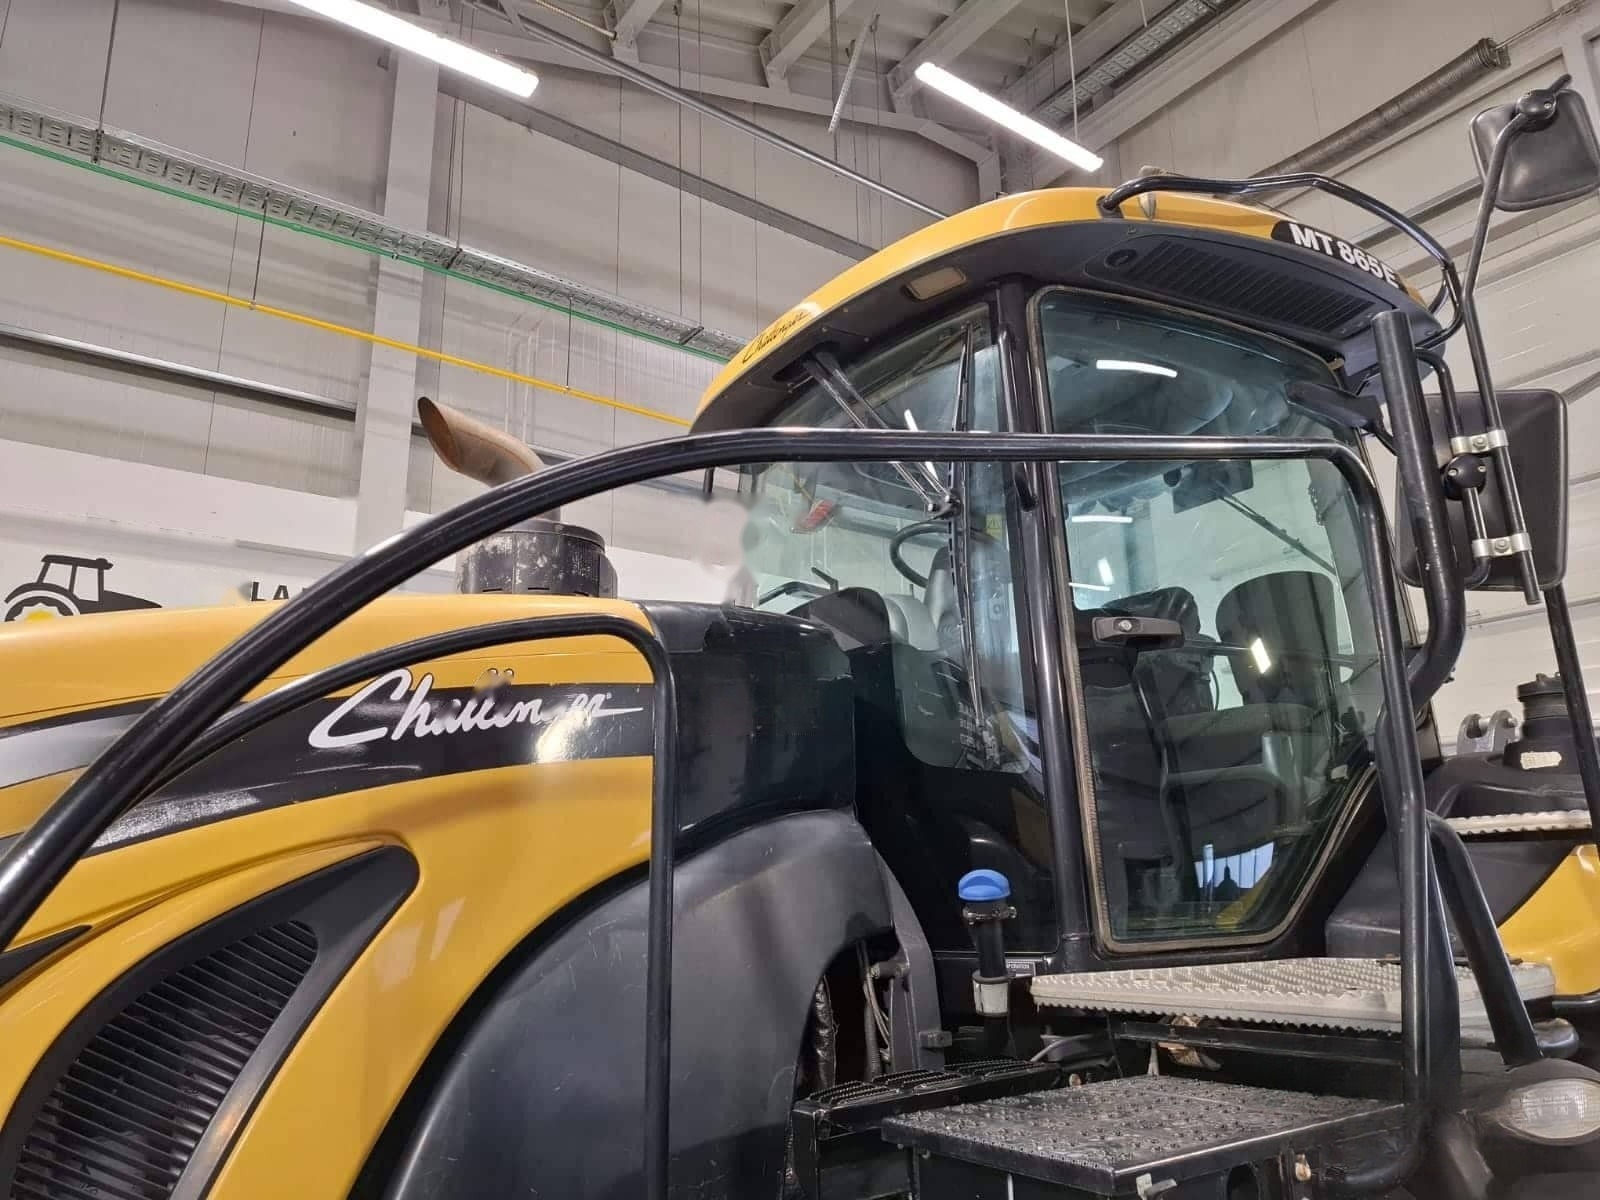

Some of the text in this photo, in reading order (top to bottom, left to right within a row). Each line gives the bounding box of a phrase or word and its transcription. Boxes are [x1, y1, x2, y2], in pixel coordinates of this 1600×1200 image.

[1289, 223, 1399, 288] MT 865E
[251, 581, 311, 601] LA
[308, 668, 643, 749] Challner
